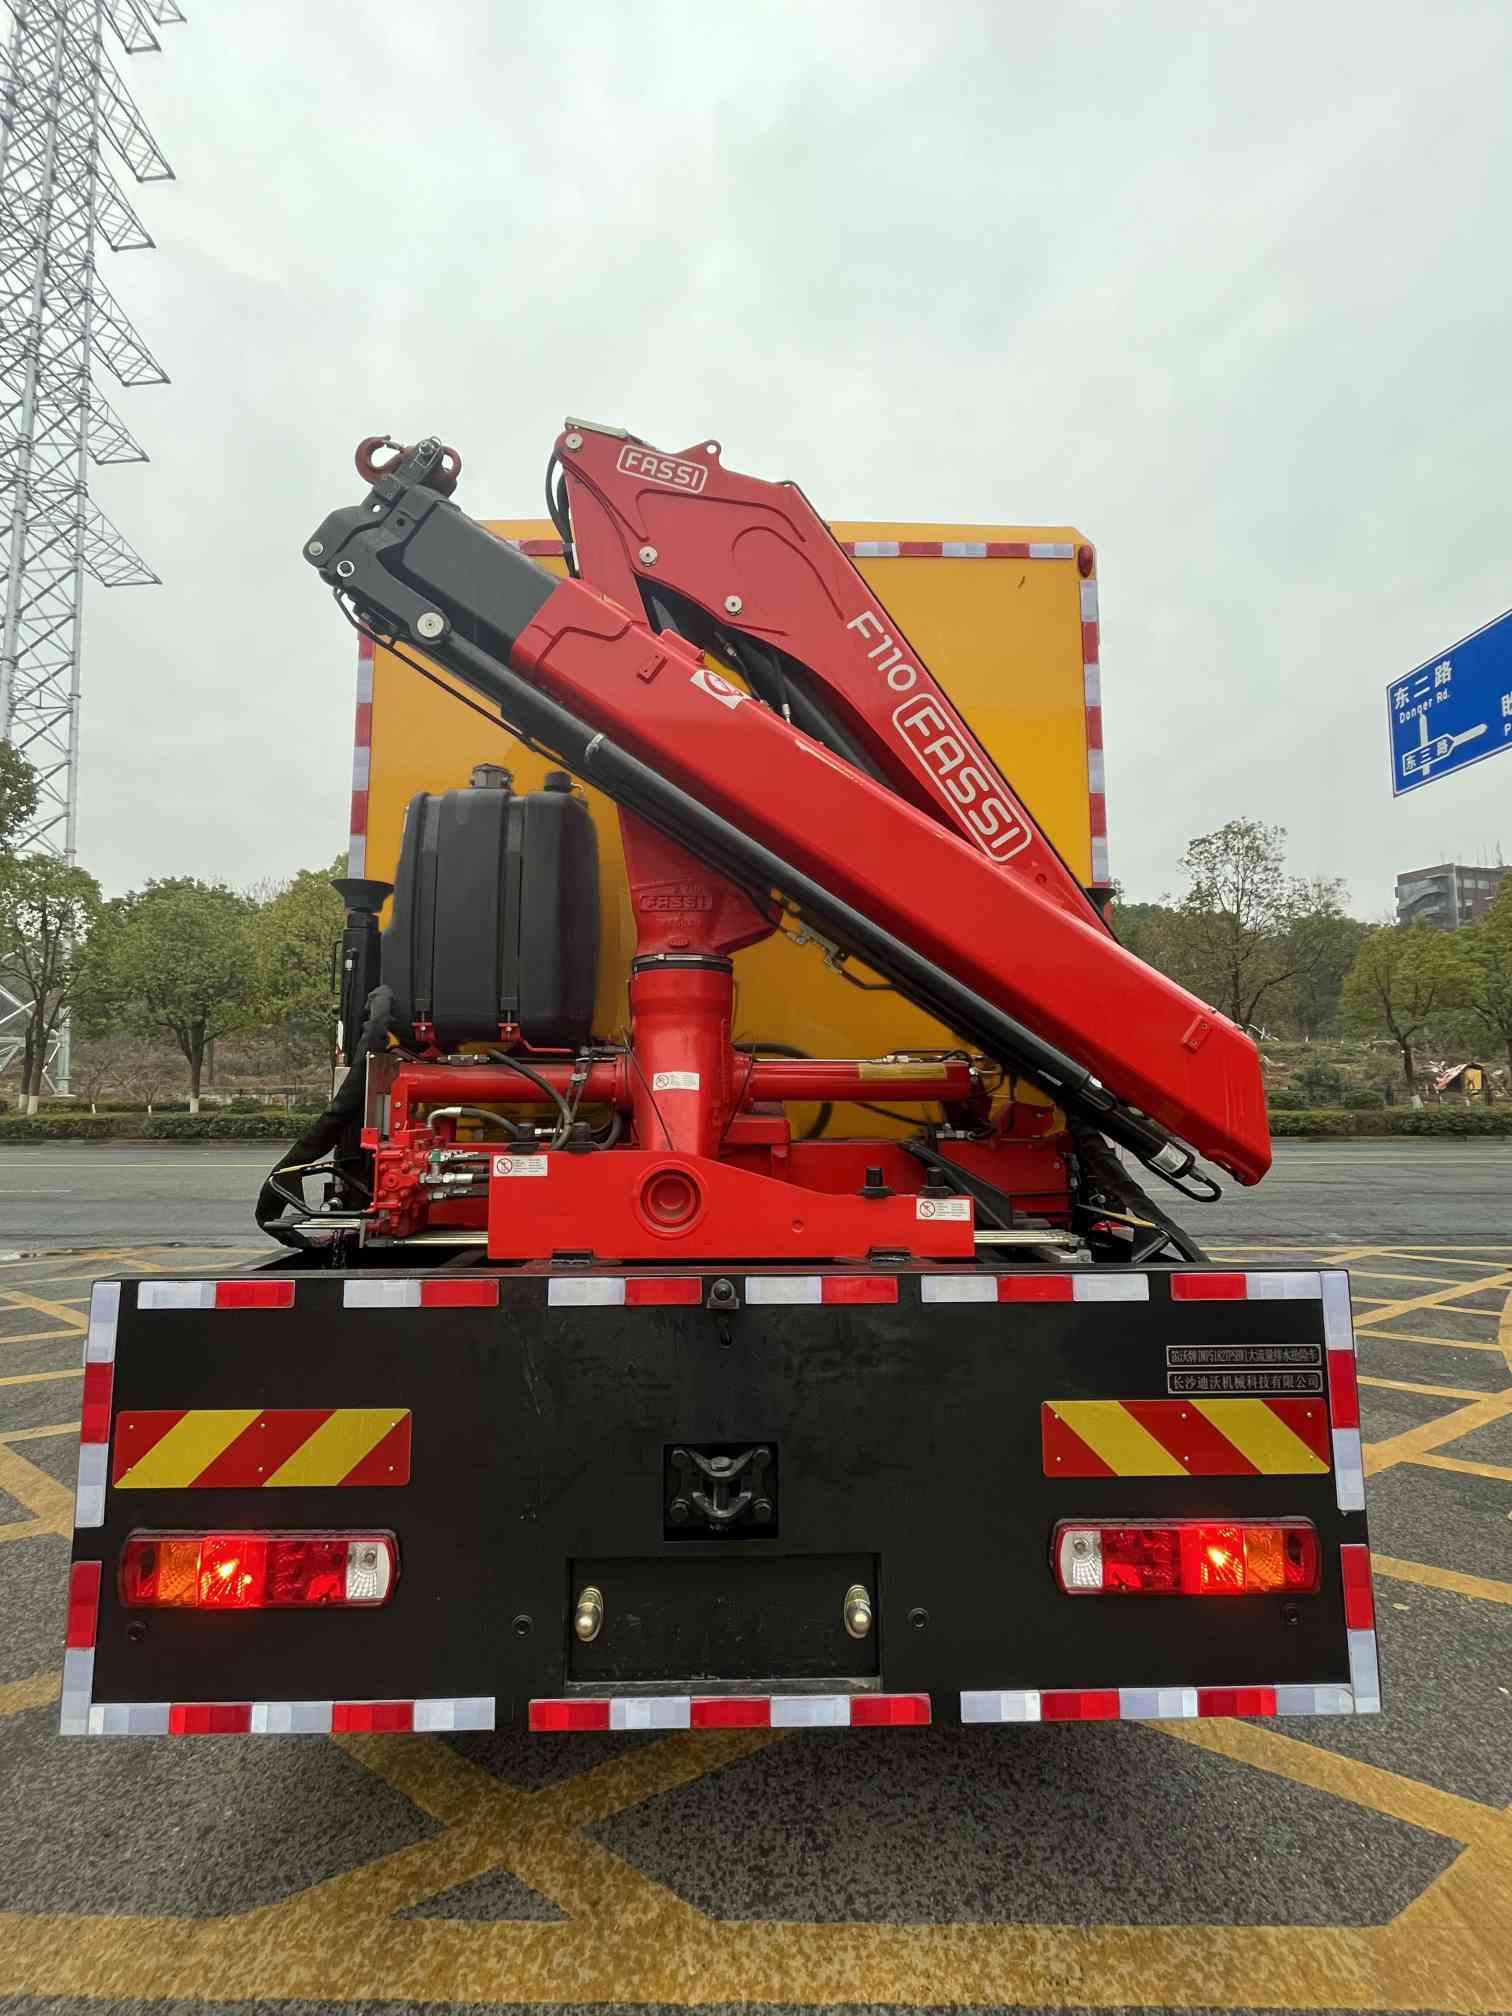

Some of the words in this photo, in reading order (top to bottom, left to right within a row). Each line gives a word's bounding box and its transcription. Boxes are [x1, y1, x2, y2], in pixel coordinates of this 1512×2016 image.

[625, 451, 700, 487] FASSI
[846, 610, 917, 691] F110
[1394, 660, 1452, 709] 东二路
[1399, 699, 1433, 724] Donger
[1405, 740, 1448, 770] 东三路
[903, 706, 1020, 849] FASSI
[645, 896, 706, 910] FASSI
[1173, 1375, 1319, 1390] 长沙迪沃机械科技有限公司
